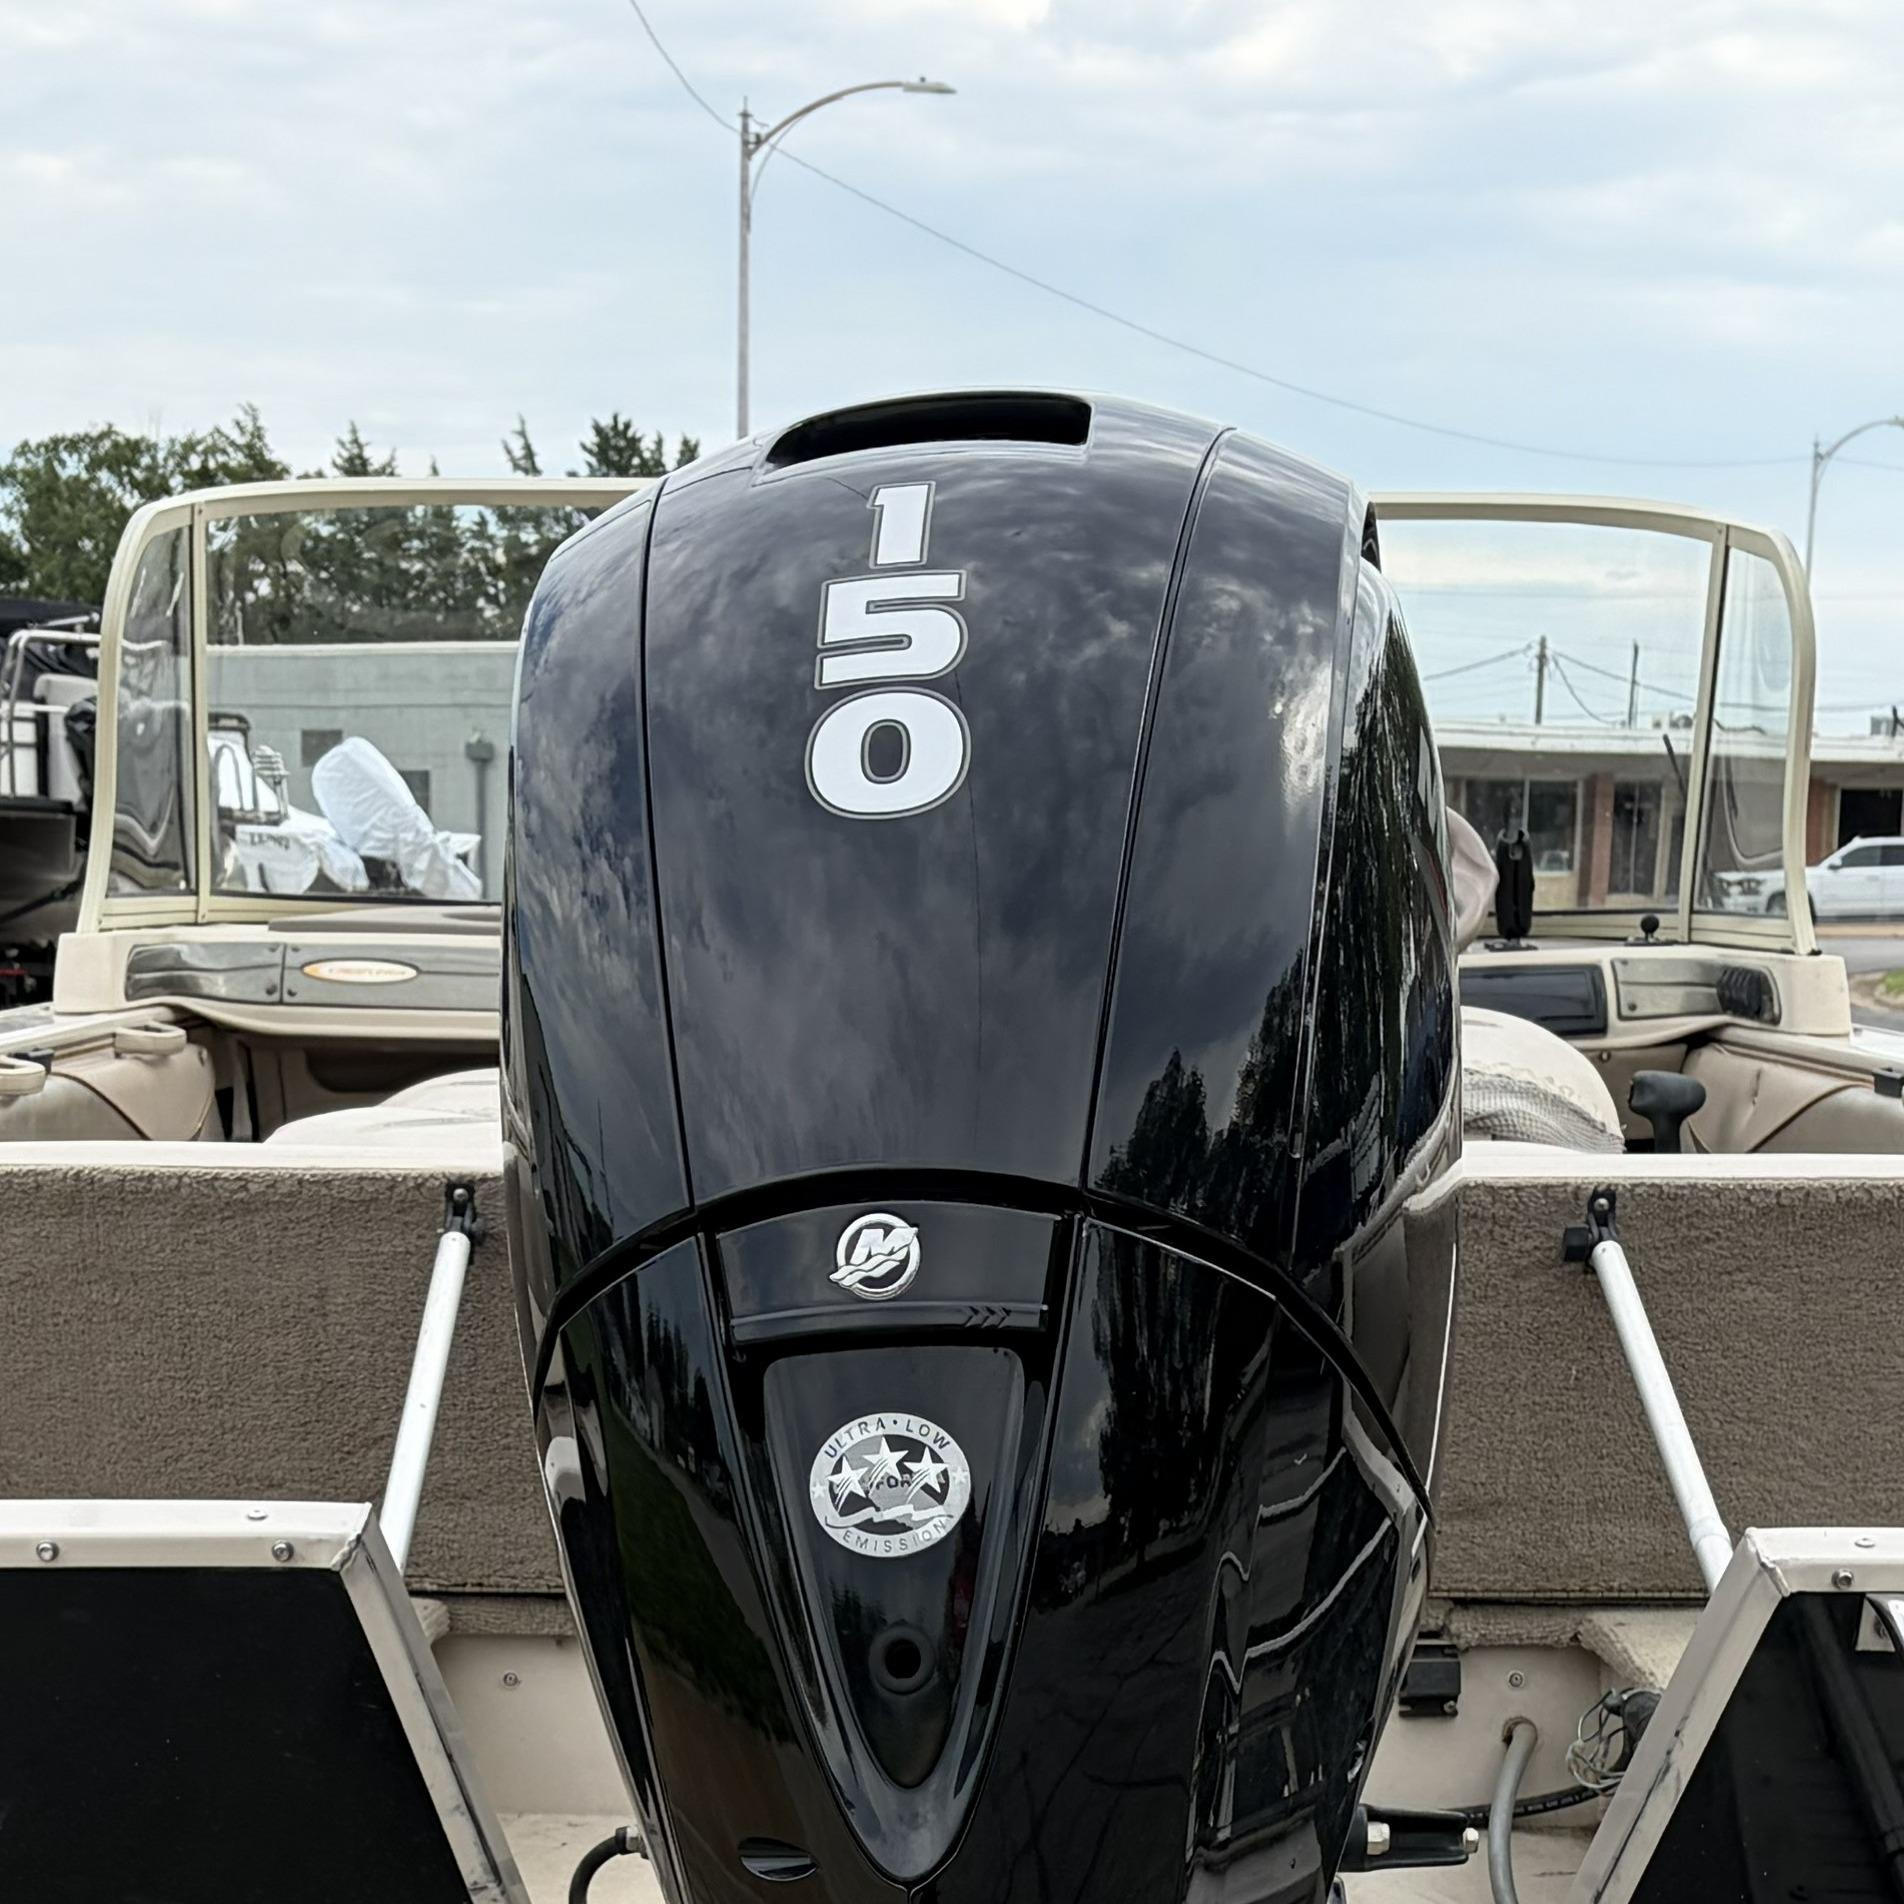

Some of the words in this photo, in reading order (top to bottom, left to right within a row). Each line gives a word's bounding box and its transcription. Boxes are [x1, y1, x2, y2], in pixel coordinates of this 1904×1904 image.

[805, 481, 972, 820] 150
[824, 1416, 886, 1459] ULTRA
[905, 1418, 951, 1451] LOW
[842, 1519, 946, 1554] EMISSION
